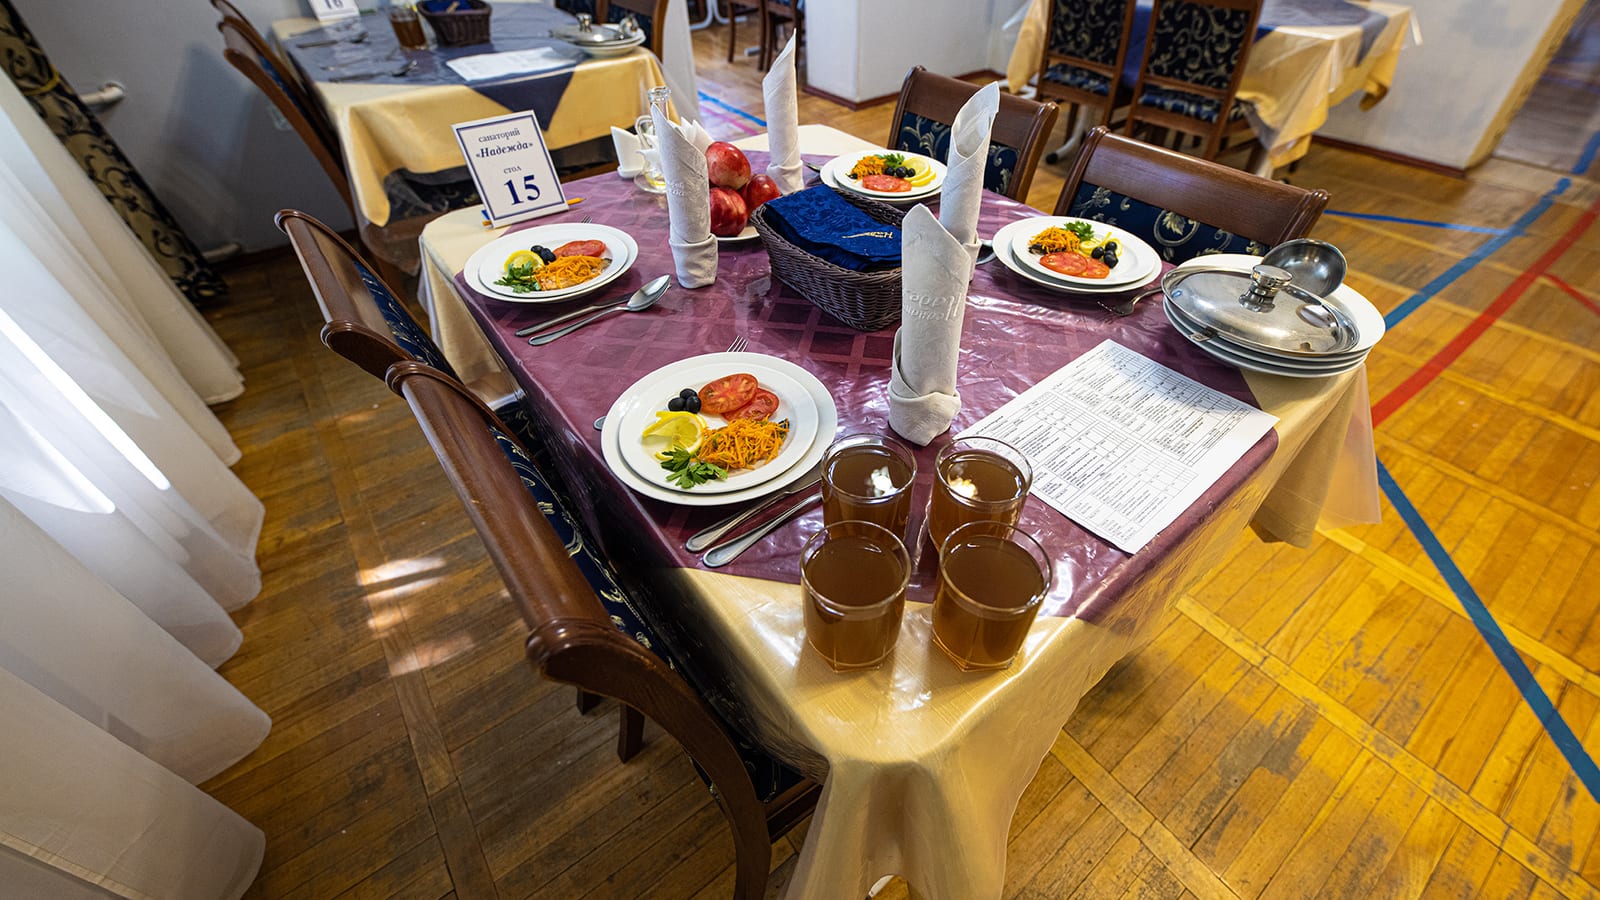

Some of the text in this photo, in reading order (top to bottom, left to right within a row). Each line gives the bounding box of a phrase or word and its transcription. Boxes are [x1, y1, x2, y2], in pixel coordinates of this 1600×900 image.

[478, 128, 521, 143] санаторий
[476, 141, 534, 158] «Надежда»
[503, 165, 522, 174] стол
[504, 174, 541, 206] 15
